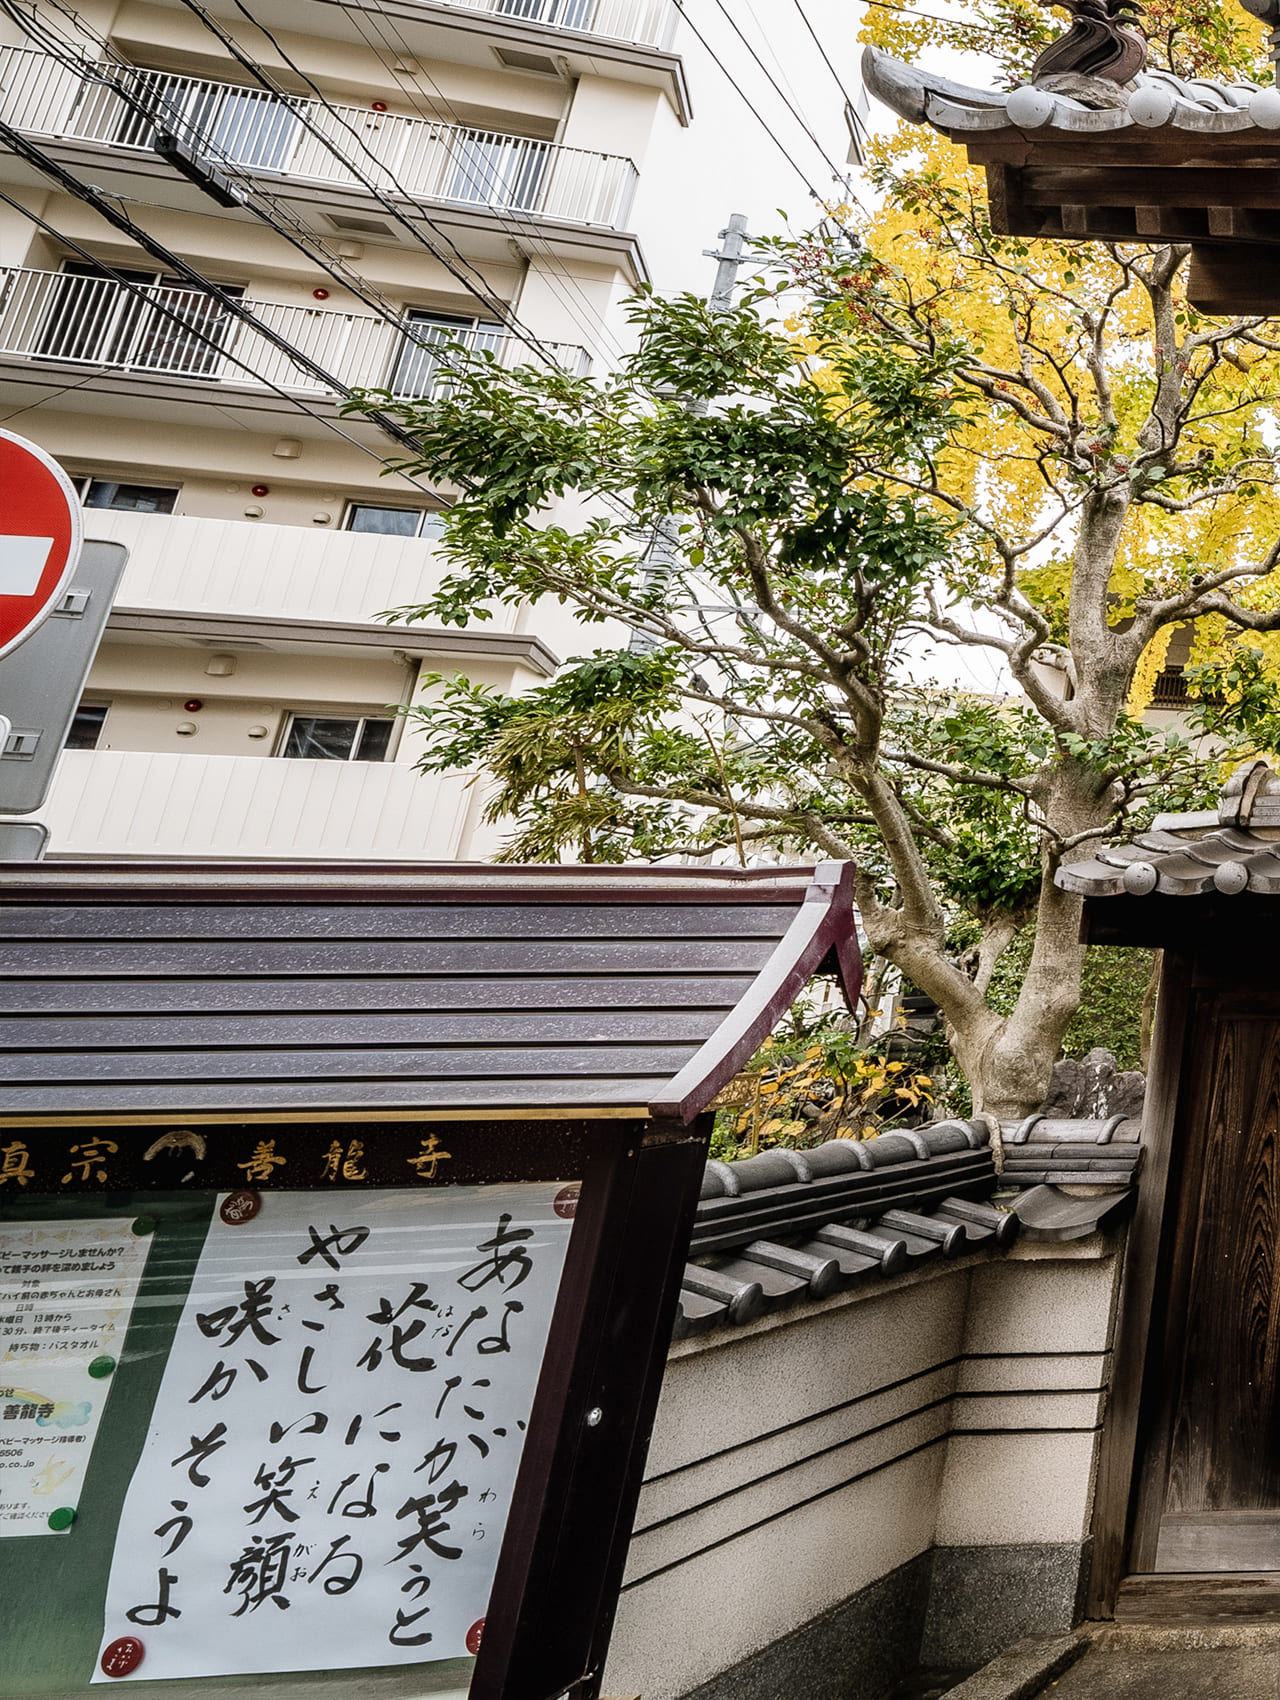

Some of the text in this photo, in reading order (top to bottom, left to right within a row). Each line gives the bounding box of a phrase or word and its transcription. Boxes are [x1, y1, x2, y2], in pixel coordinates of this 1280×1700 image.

[237, 1131, 454, 1183] 善龍寺
[0, 1247, 125, 1260] ビーマッサージしませんか?
[0, 1288, 122, 1300] ハイ前の赤ちゃんとお母さん
[3, 1403, 55, 1421] 善龍寺
[126, 1275, 282, 1627] 咲かそうよ
[223, 1223, 370, 1618] やさしい笑顔
[308, 1282, 439, 1596] 花になる
[384, 1212, 536, 1647] あなたが笑うと
